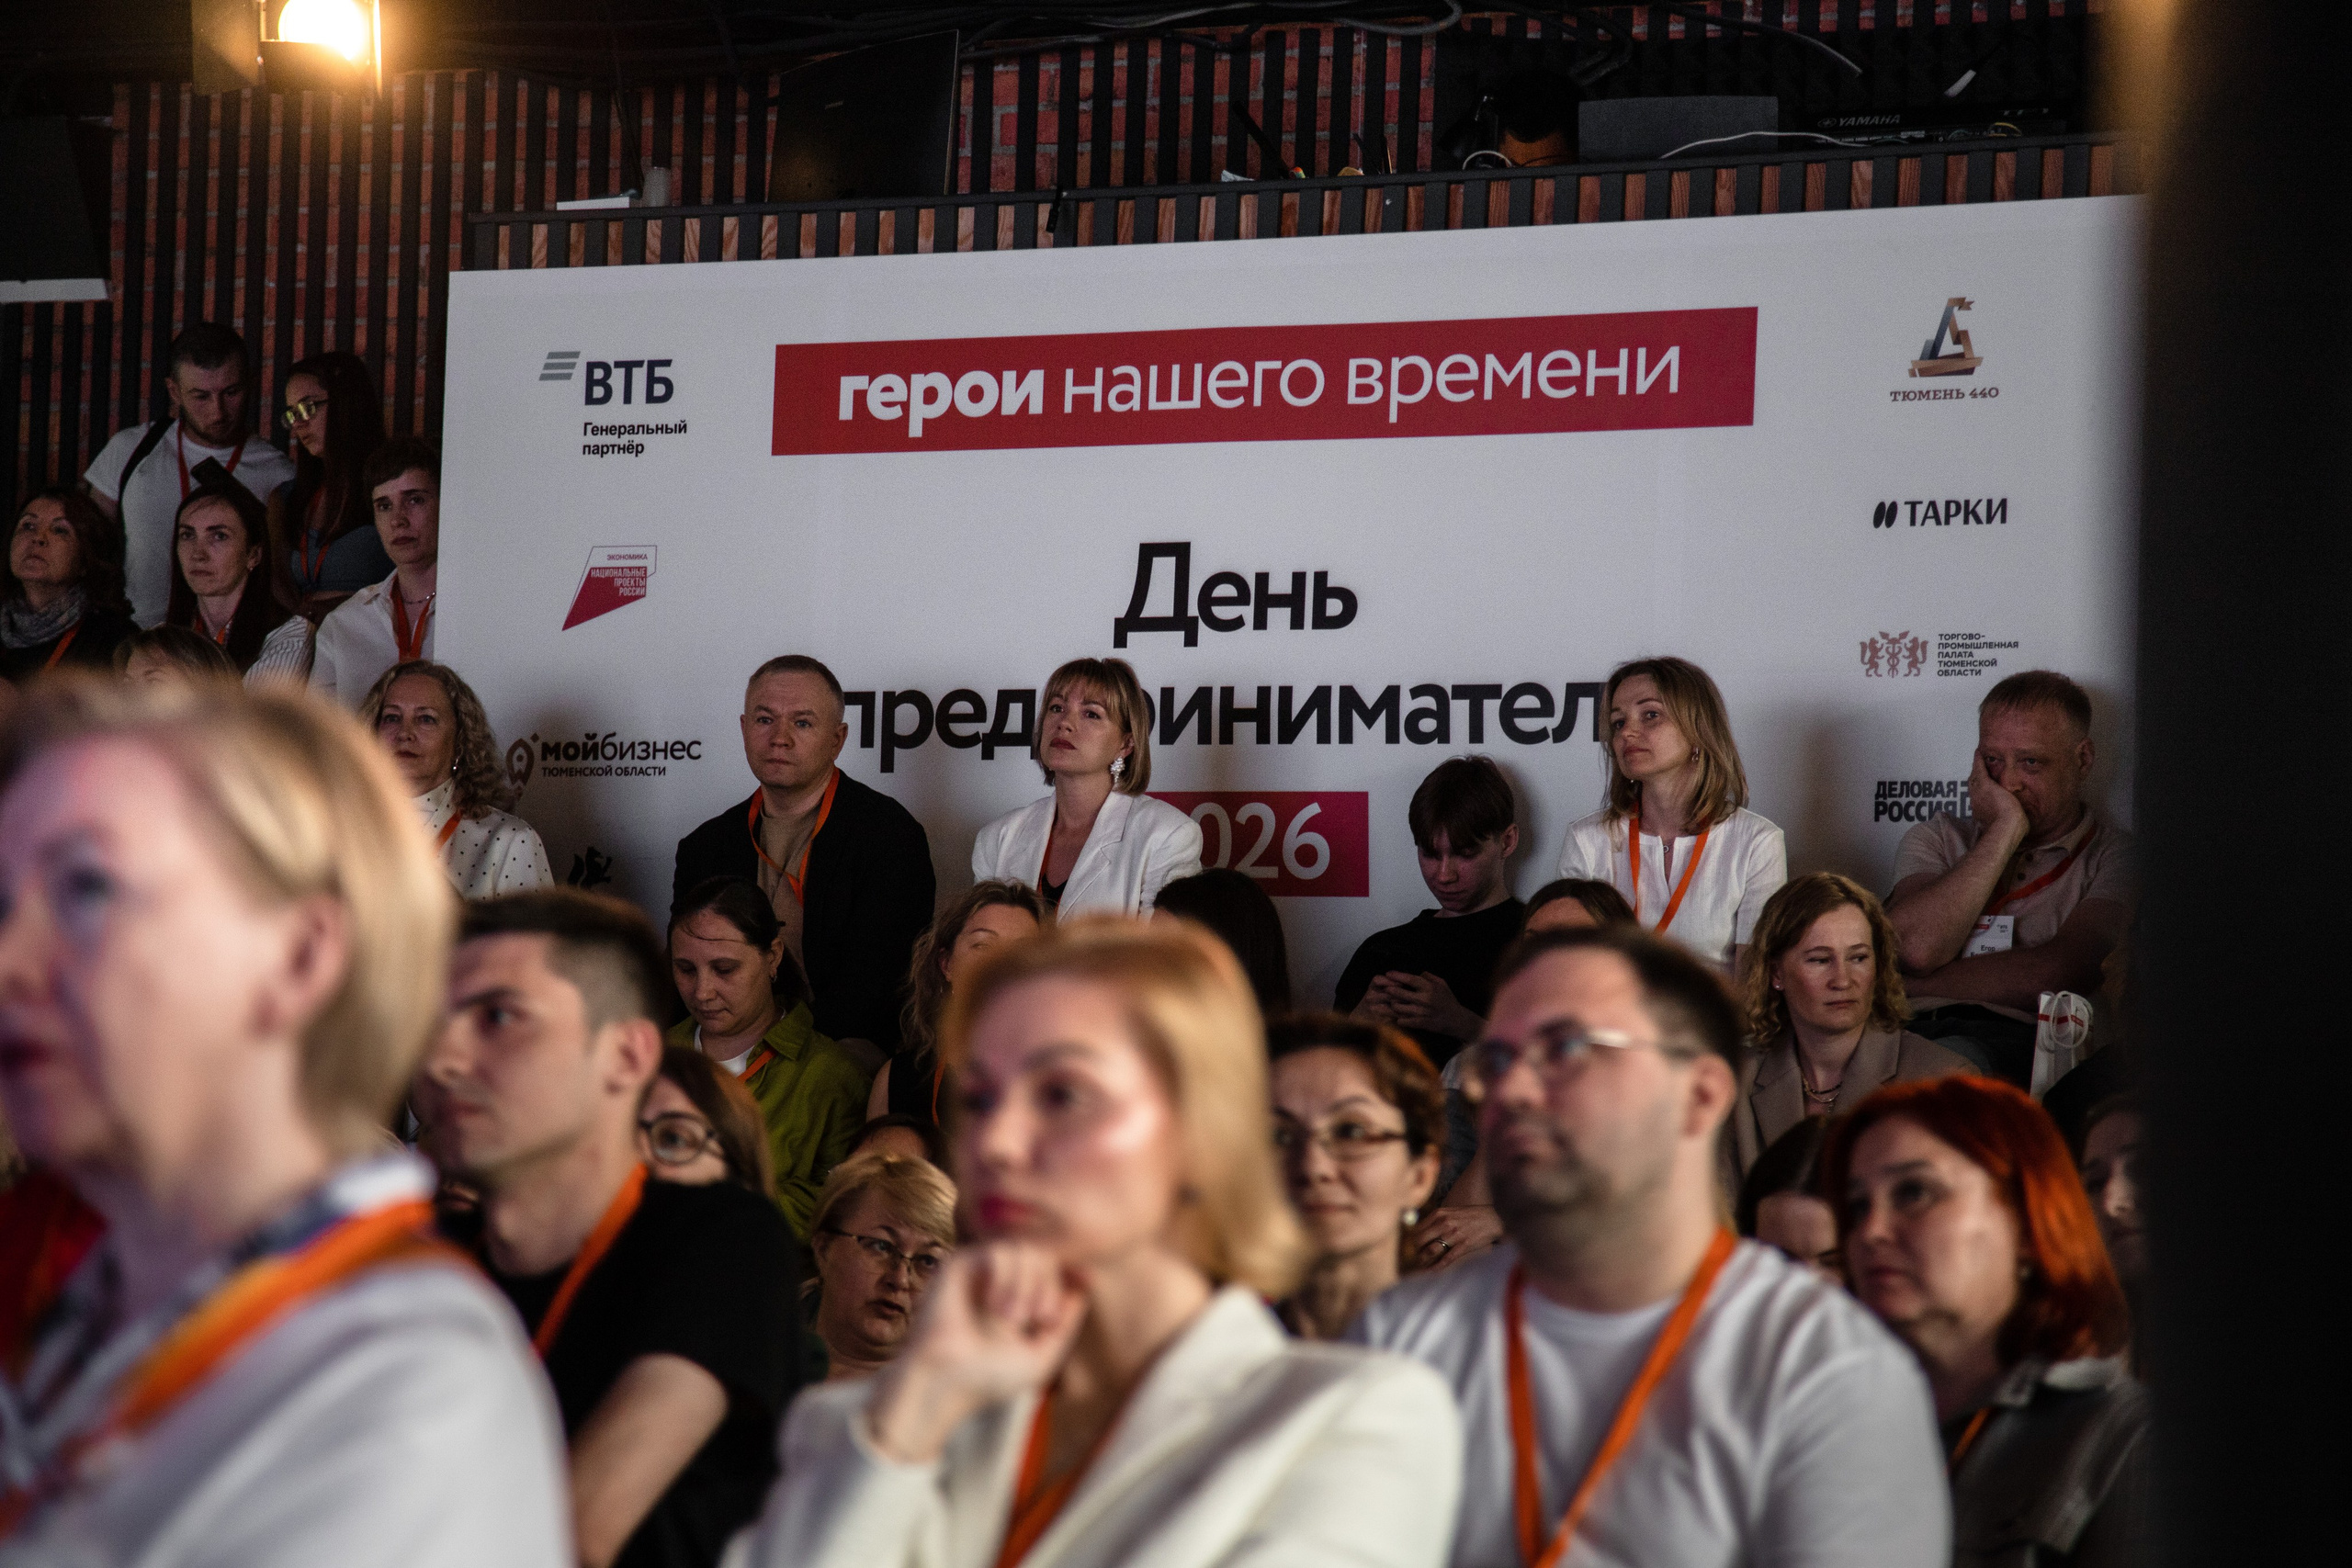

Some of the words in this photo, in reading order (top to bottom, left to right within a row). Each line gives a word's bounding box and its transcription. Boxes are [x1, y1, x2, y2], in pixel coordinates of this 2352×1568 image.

[1839, 114, 1901, 127] YAMAHA
[584, 359, 674, 405] ВТБ
[838, 368, 1045, 437] герои
[1063, 358, 1325, 414] нашего
[1347, 345, 1680, 423] времени
[1890, 389, 1965, 401] ТЮМЕНЬ
[1969, 387, 2000, 399] 440
[583, 419, 687, 438] Генеральный
[582, 440, 645, 457] партнёр
[1904, 498, 2007, 526] ТАРКИ
[591, 568, 646, 578] НАЦИОНАЛЬНЫЕ
[614, 578, 646, 587] ПРОЕКТЫ
[618, 587, 645, 596] РОССИИ
[1114, 541, 1359, 649] День
[1939, 633, 1985, 641] ТОРГОВО-
[1938, 641, 2019, 650] ПРОМЫШЛЕННАЯ
[1938, 659, 1997, 668] ТЮМЕНСКОЙ
[1937, 669, 1982, 677] ОБЛАСТИ
[542, 765, 613, 777] ТЮМЕНСКОЙ
[615, 766, 666, 776] ОБЛАСТИ
[1874, 781, 1958, 800] ДЕЛОВАЯ
[1190, 802, 1330, 880] 026
